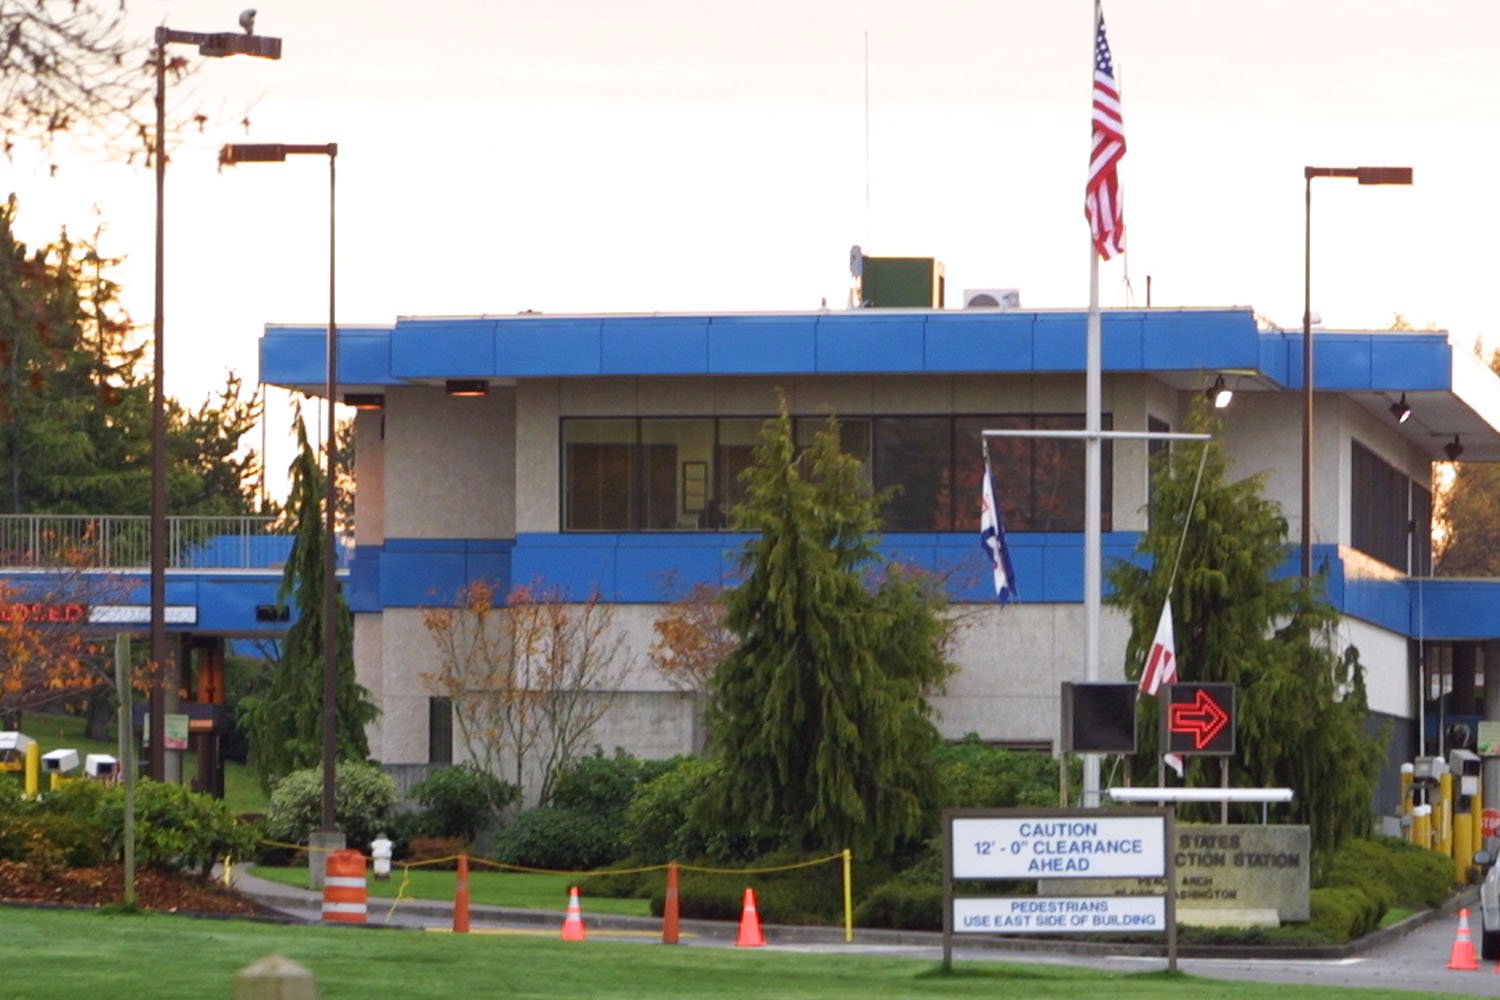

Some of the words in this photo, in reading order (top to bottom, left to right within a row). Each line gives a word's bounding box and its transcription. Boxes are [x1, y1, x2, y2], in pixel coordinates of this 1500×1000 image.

[1019, 823, 1097, 837] CAUTION
[1033, 840, 1143, 854] CLEARANCE
[1179, 834, 1241, 849] STATES
[1027, 858, 1090, 872] AHEAD
[1233, 853, 1300, 868] STATION
[1173, 890, 1238, 899] ASHINGTON
[1011, 901, 1108, 913] PEDESTRIANS
[964, 915, 991, 927] USE
[994, 915, 1033, 927] EAST
[1036, 915, 1068, 927] SIDE
[1070, 914, 1090, 926] OF
[1092, 914, 1157, 926] BUILDING
